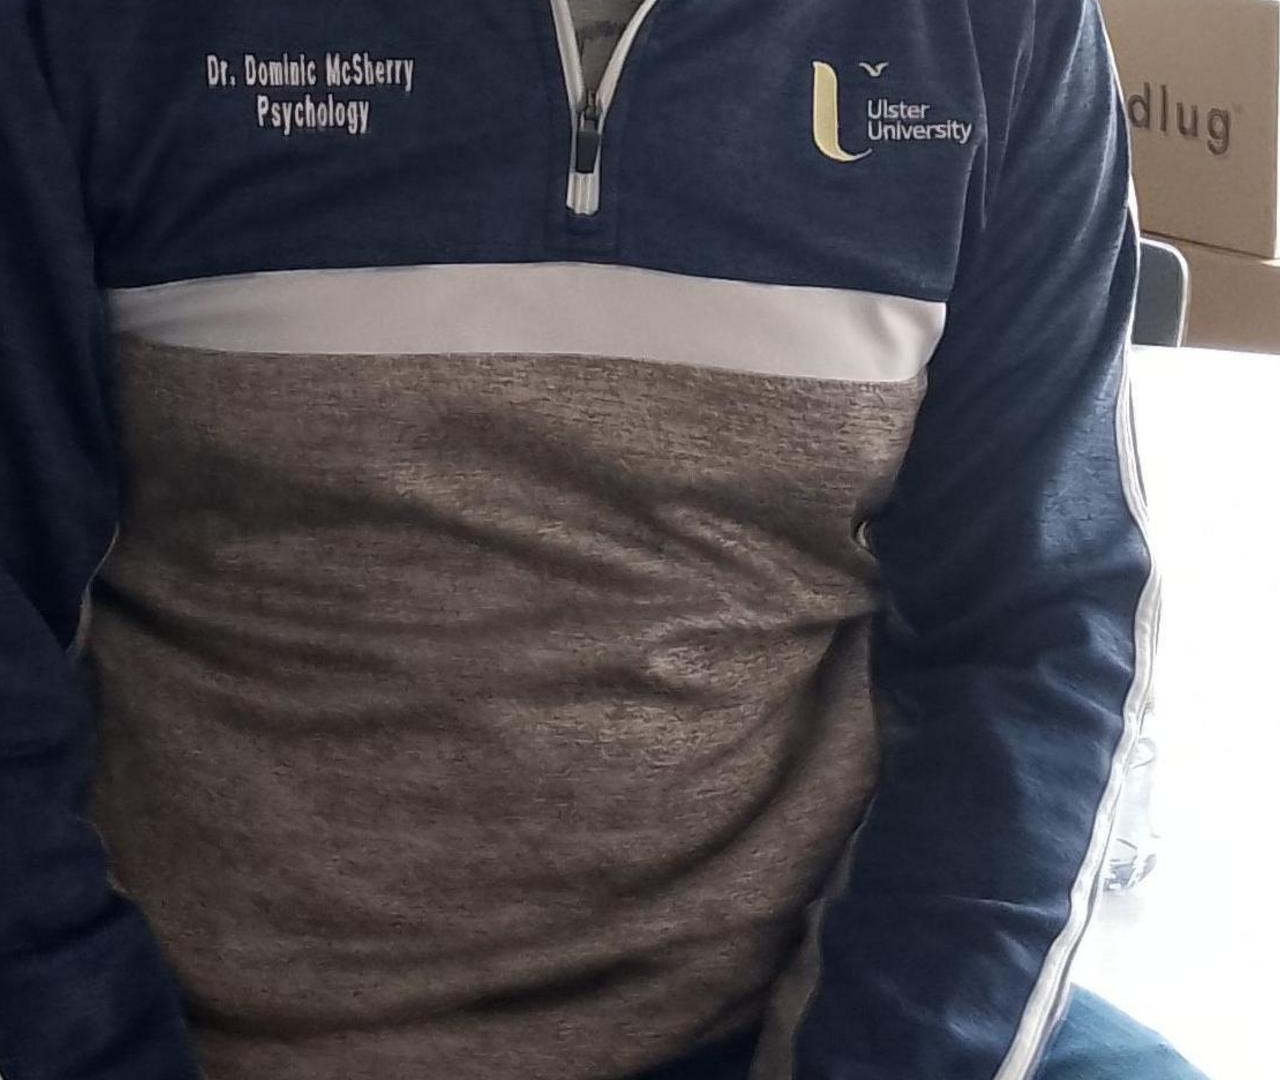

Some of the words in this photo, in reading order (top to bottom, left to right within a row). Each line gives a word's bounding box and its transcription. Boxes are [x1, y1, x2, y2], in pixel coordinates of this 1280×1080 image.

[206, 54, 236, 87] Dr.
[244, 53, 317, 87] Dominic
[325, 52, 414, 93] McSherry
[256, 94, 370, 136] Psychology
[867, 99, 931, 120] Ulster
[867, 120, 972, 144] University
